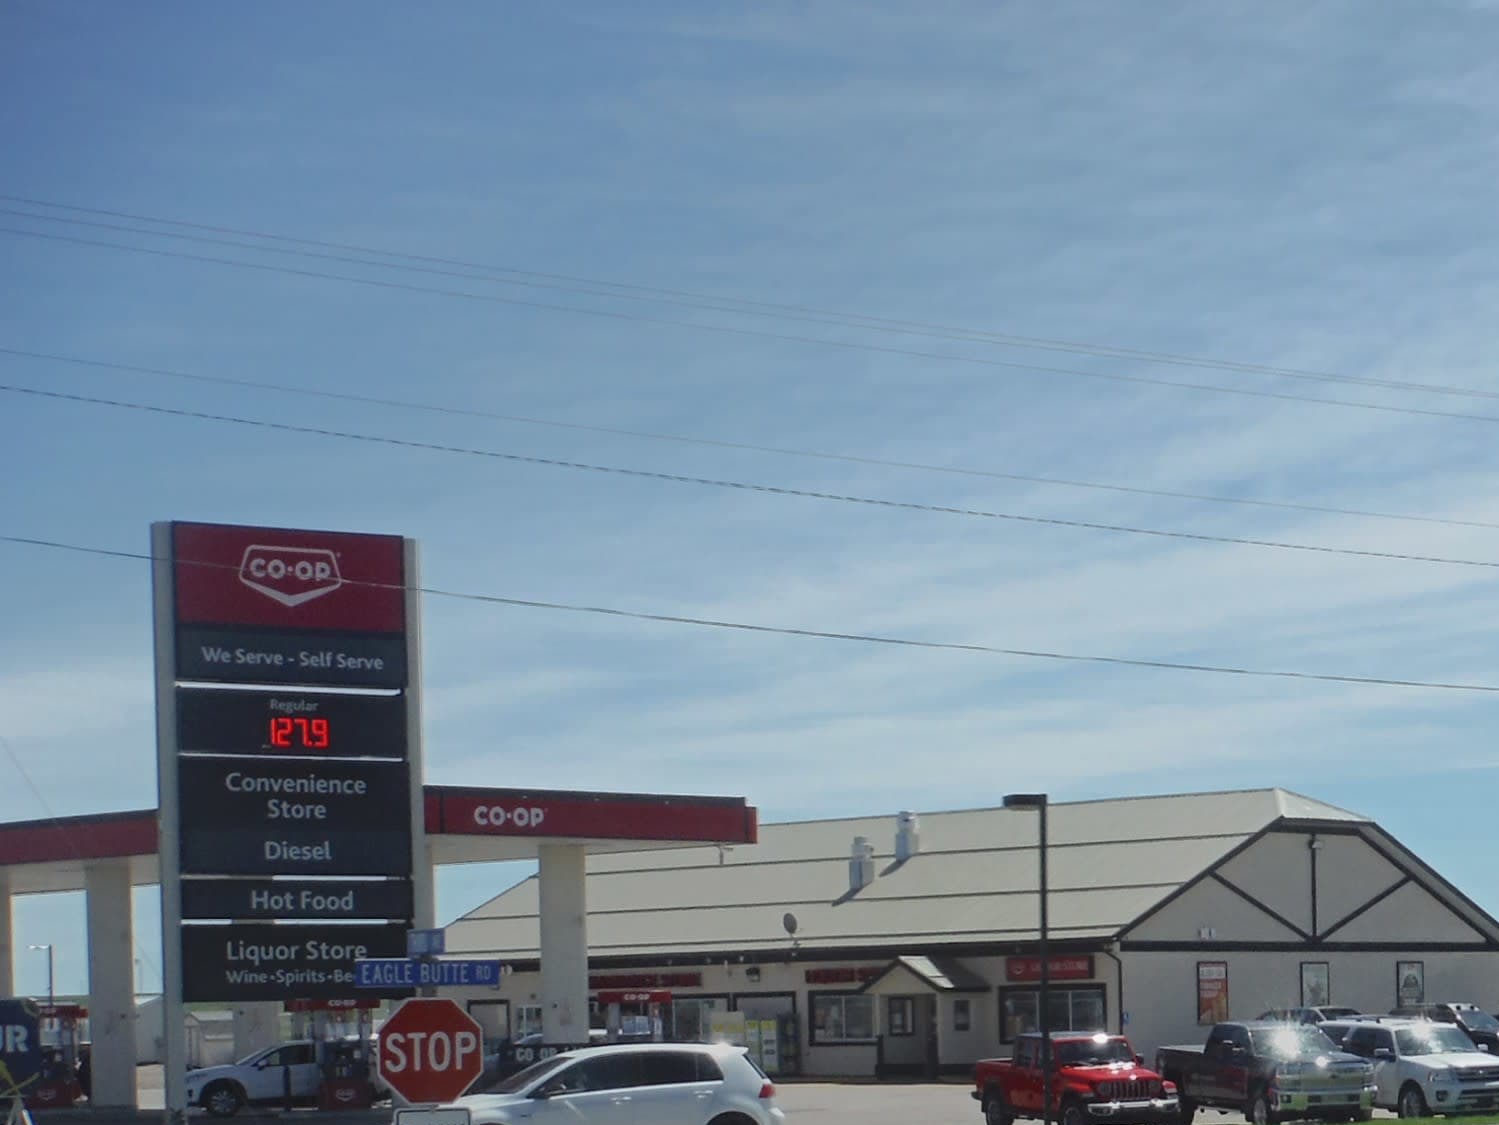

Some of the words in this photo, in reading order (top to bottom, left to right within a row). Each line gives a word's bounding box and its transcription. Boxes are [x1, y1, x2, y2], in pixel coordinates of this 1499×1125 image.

[200, 646, 232, 664] We
[236, 648, 284, 666] Serve
[299, 651, 334, 669] Self
[336, 653, 385, 671] Serve
[269, 698, 320, 713] Regular
[224, 772, 368, 795] Convenience
[266, 799, 328, 820] Store
[263, 840, 333, 861] Diesel
[251, 890, 295, 911] Hot
[300, 890, 354, 911] Food
[226, 940, 299, 966] Liquor
[305, 940, 368, 961] Store
[361, 964, 414, 985] EAGLE
[420, 963, 470, 983] BUTTE
[476, 965, 492, 981] RD
[384, 1031, 477, 1073] STOP
